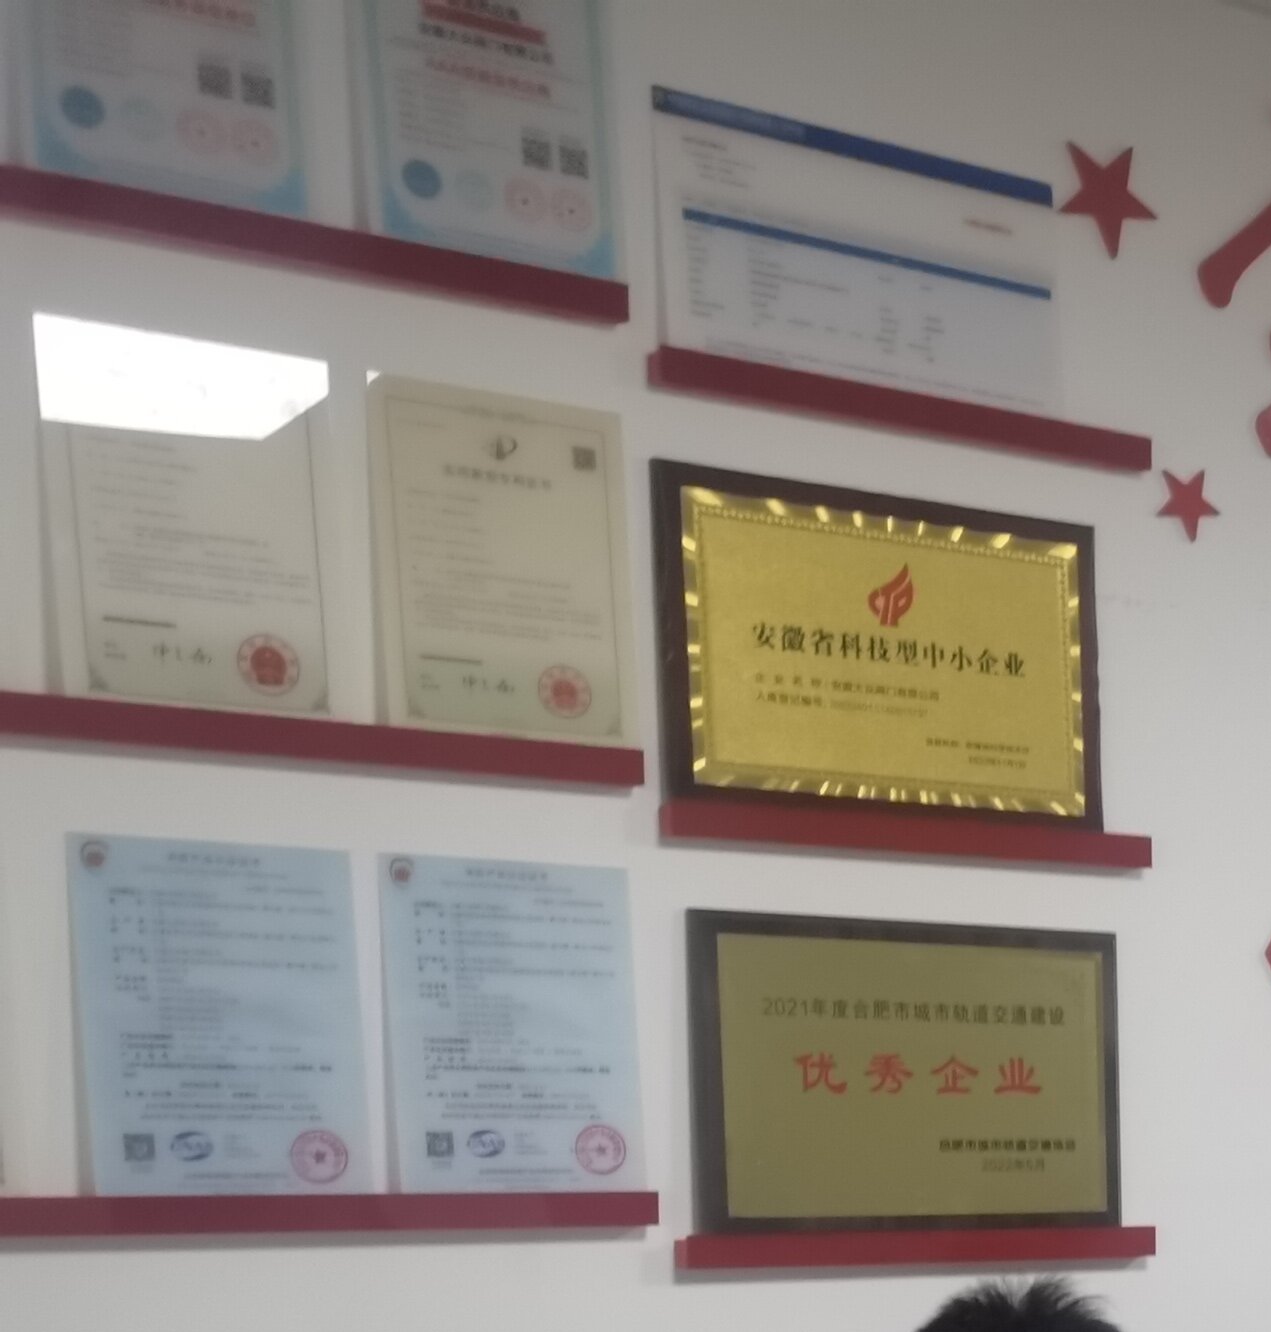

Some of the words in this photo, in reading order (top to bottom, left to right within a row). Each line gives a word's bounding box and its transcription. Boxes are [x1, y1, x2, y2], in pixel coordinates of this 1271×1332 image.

[752, 621, 1027, 678] 安徽省科技型中小企业
[762, 996, 1066, 1027] 2021年度合肥市城市轨道交通建设
[793, 1052, 1043, 1097] 优秀企业
